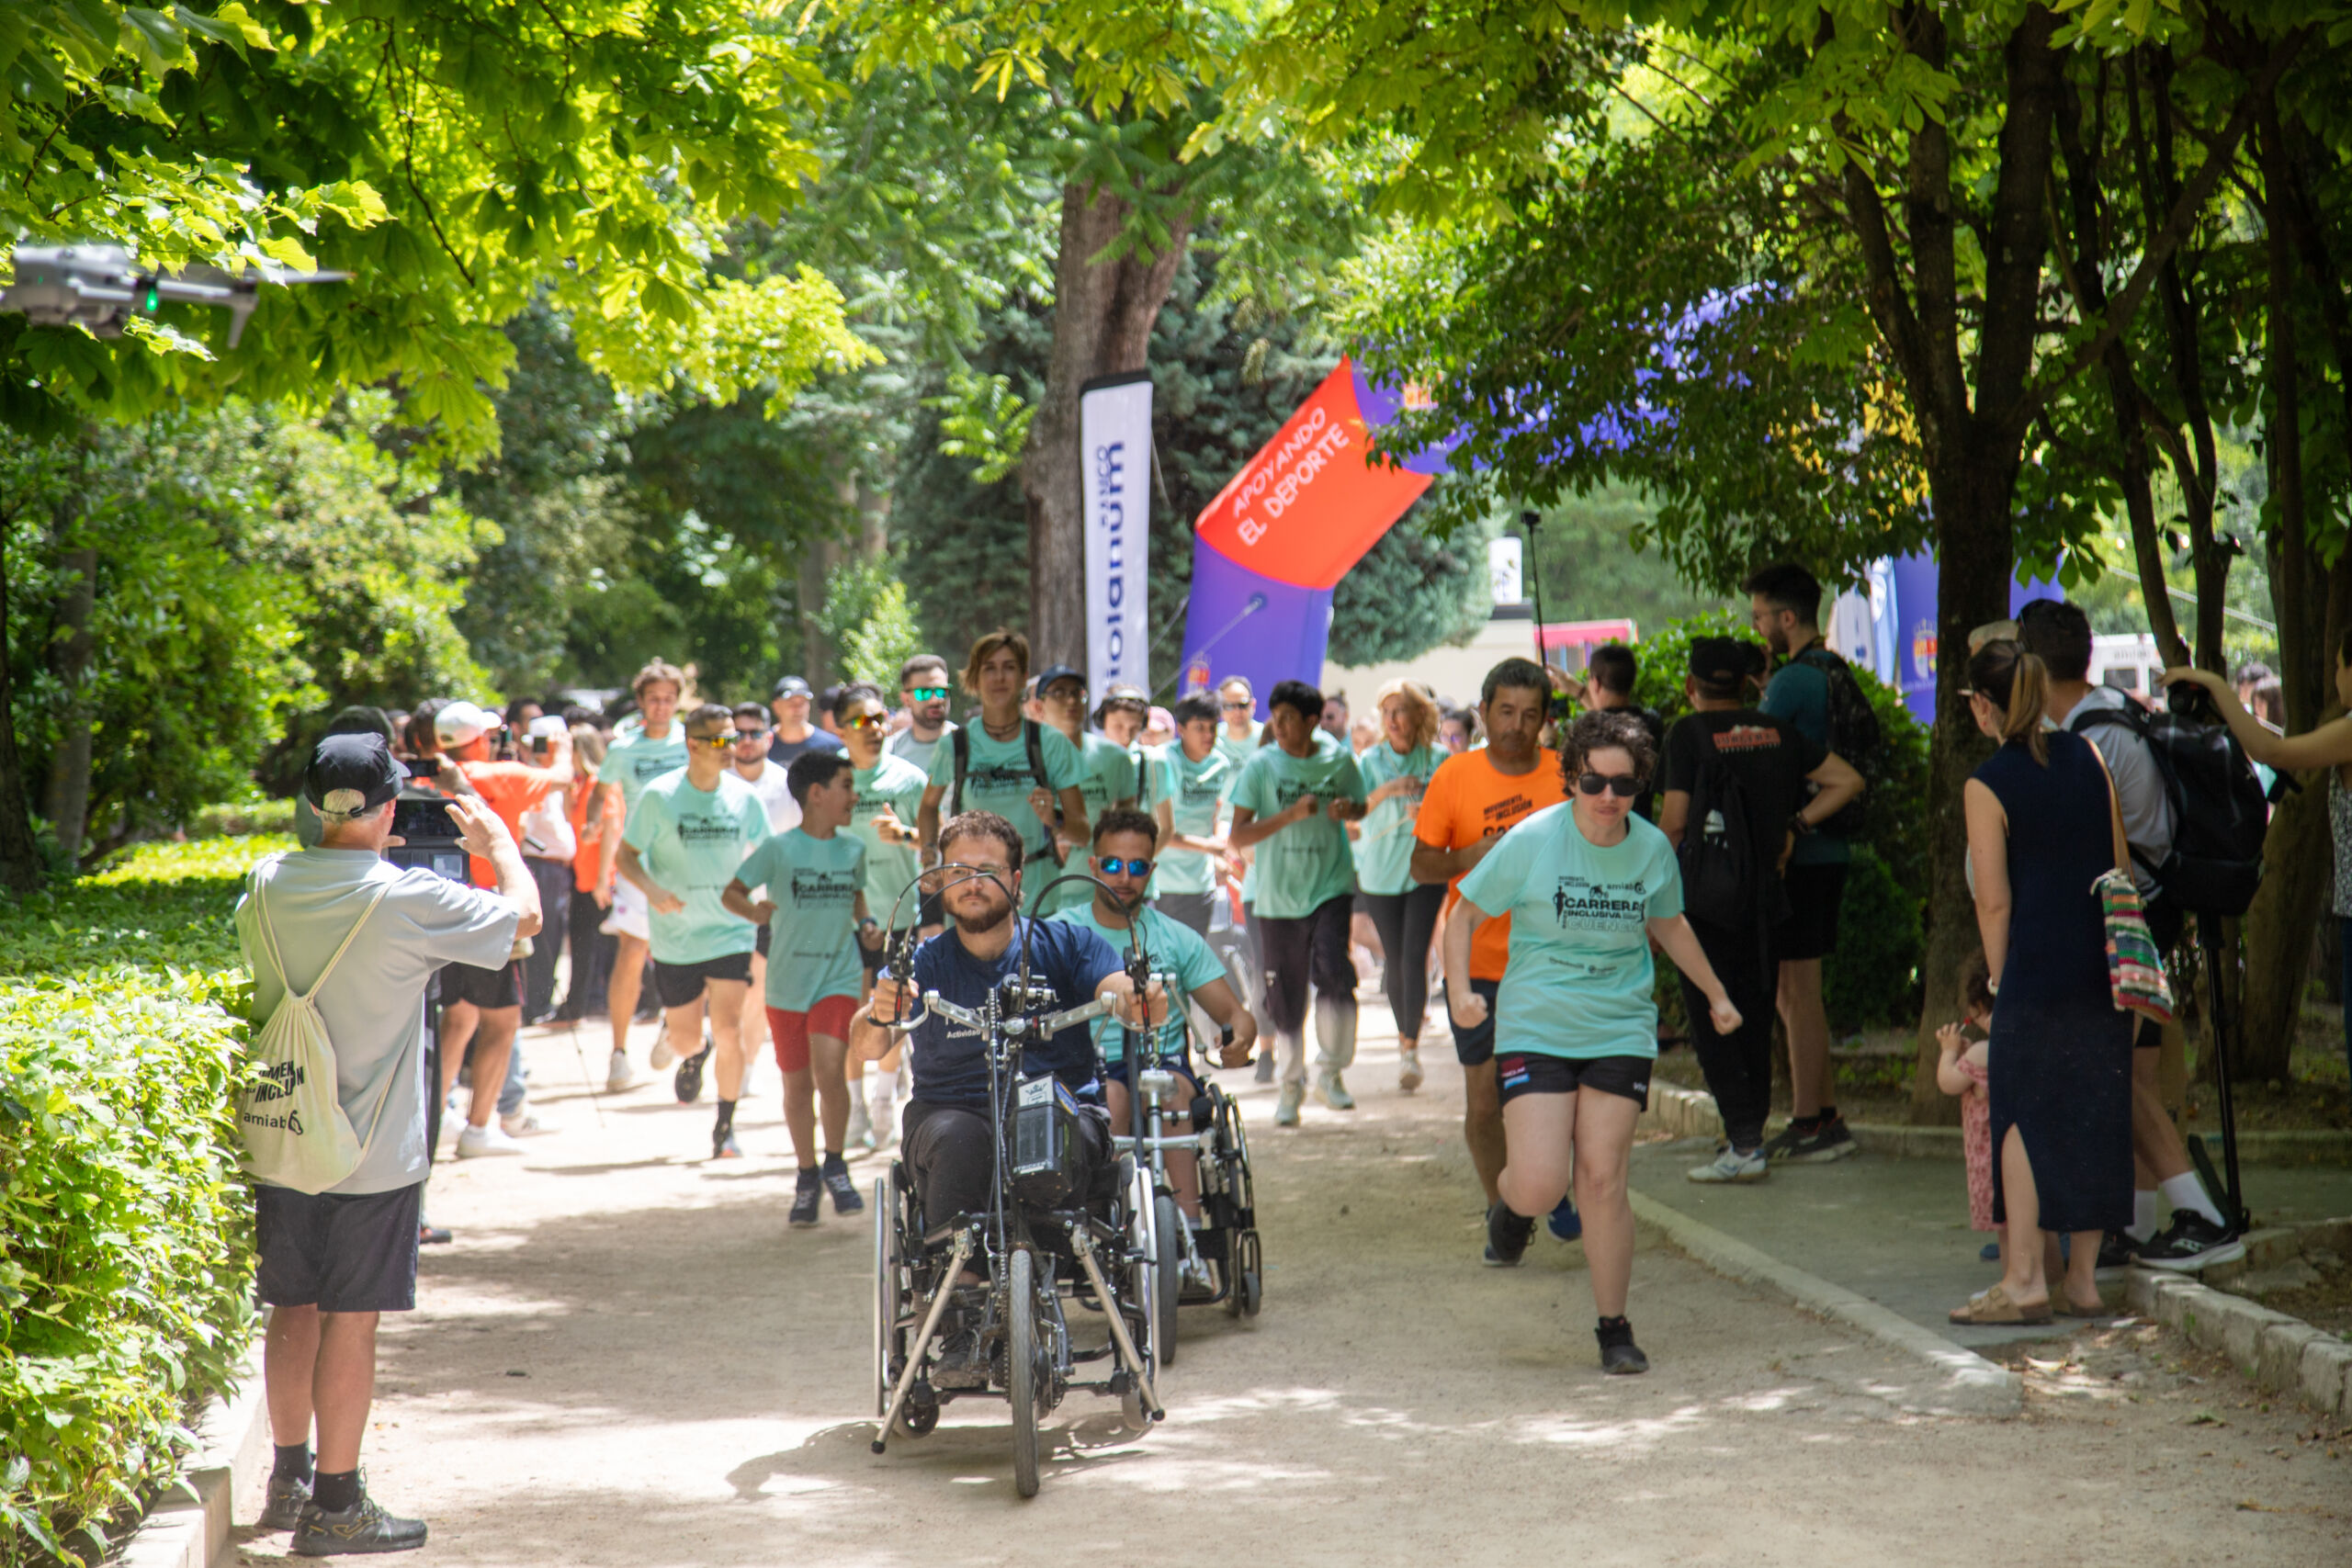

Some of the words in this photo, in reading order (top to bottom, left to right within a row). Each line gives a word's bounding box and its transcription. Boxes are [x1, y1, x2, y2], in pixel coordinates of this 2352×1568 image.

[1233, 407, 1326, 519] APOYANDO
[1237, 516, 1268, 547] EL
[1262, 423, 1351, 518] DEPORTE
[1565, 897, 1643, 912] CARRERA
[243, 1112, 287, 1129] amiab
